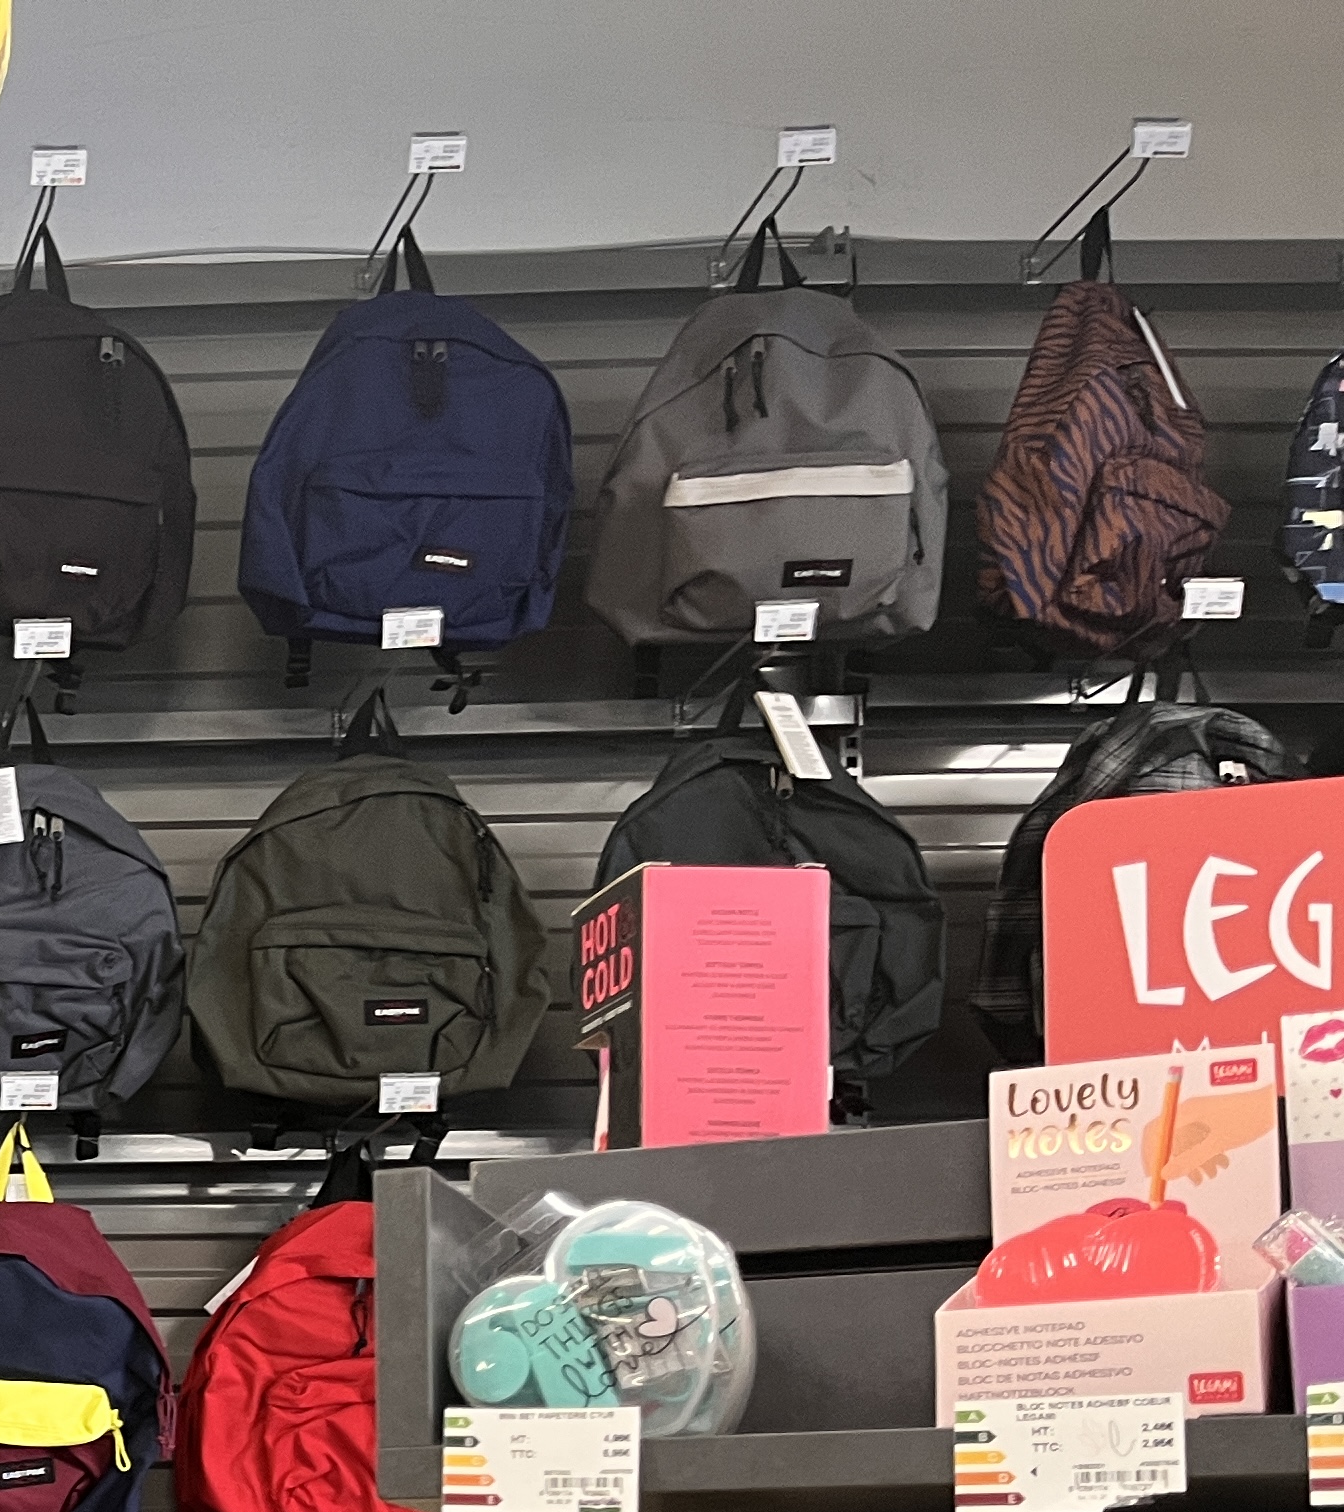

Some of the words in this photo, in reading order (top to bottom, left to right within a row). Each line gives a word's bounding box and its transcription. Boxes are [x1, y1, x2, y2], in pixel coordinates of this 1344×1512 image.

[581, 903, 620, 967] HOT
[1112, 850, 1333, 1005] LEG
[582, 946, 634, 1011] COLD
[1008, 1072, 1141, 1118] Lovely
[1007, 1113, 1133, 1160] notes
[1022, 1320, 1086, 1334] NOTEPAD
